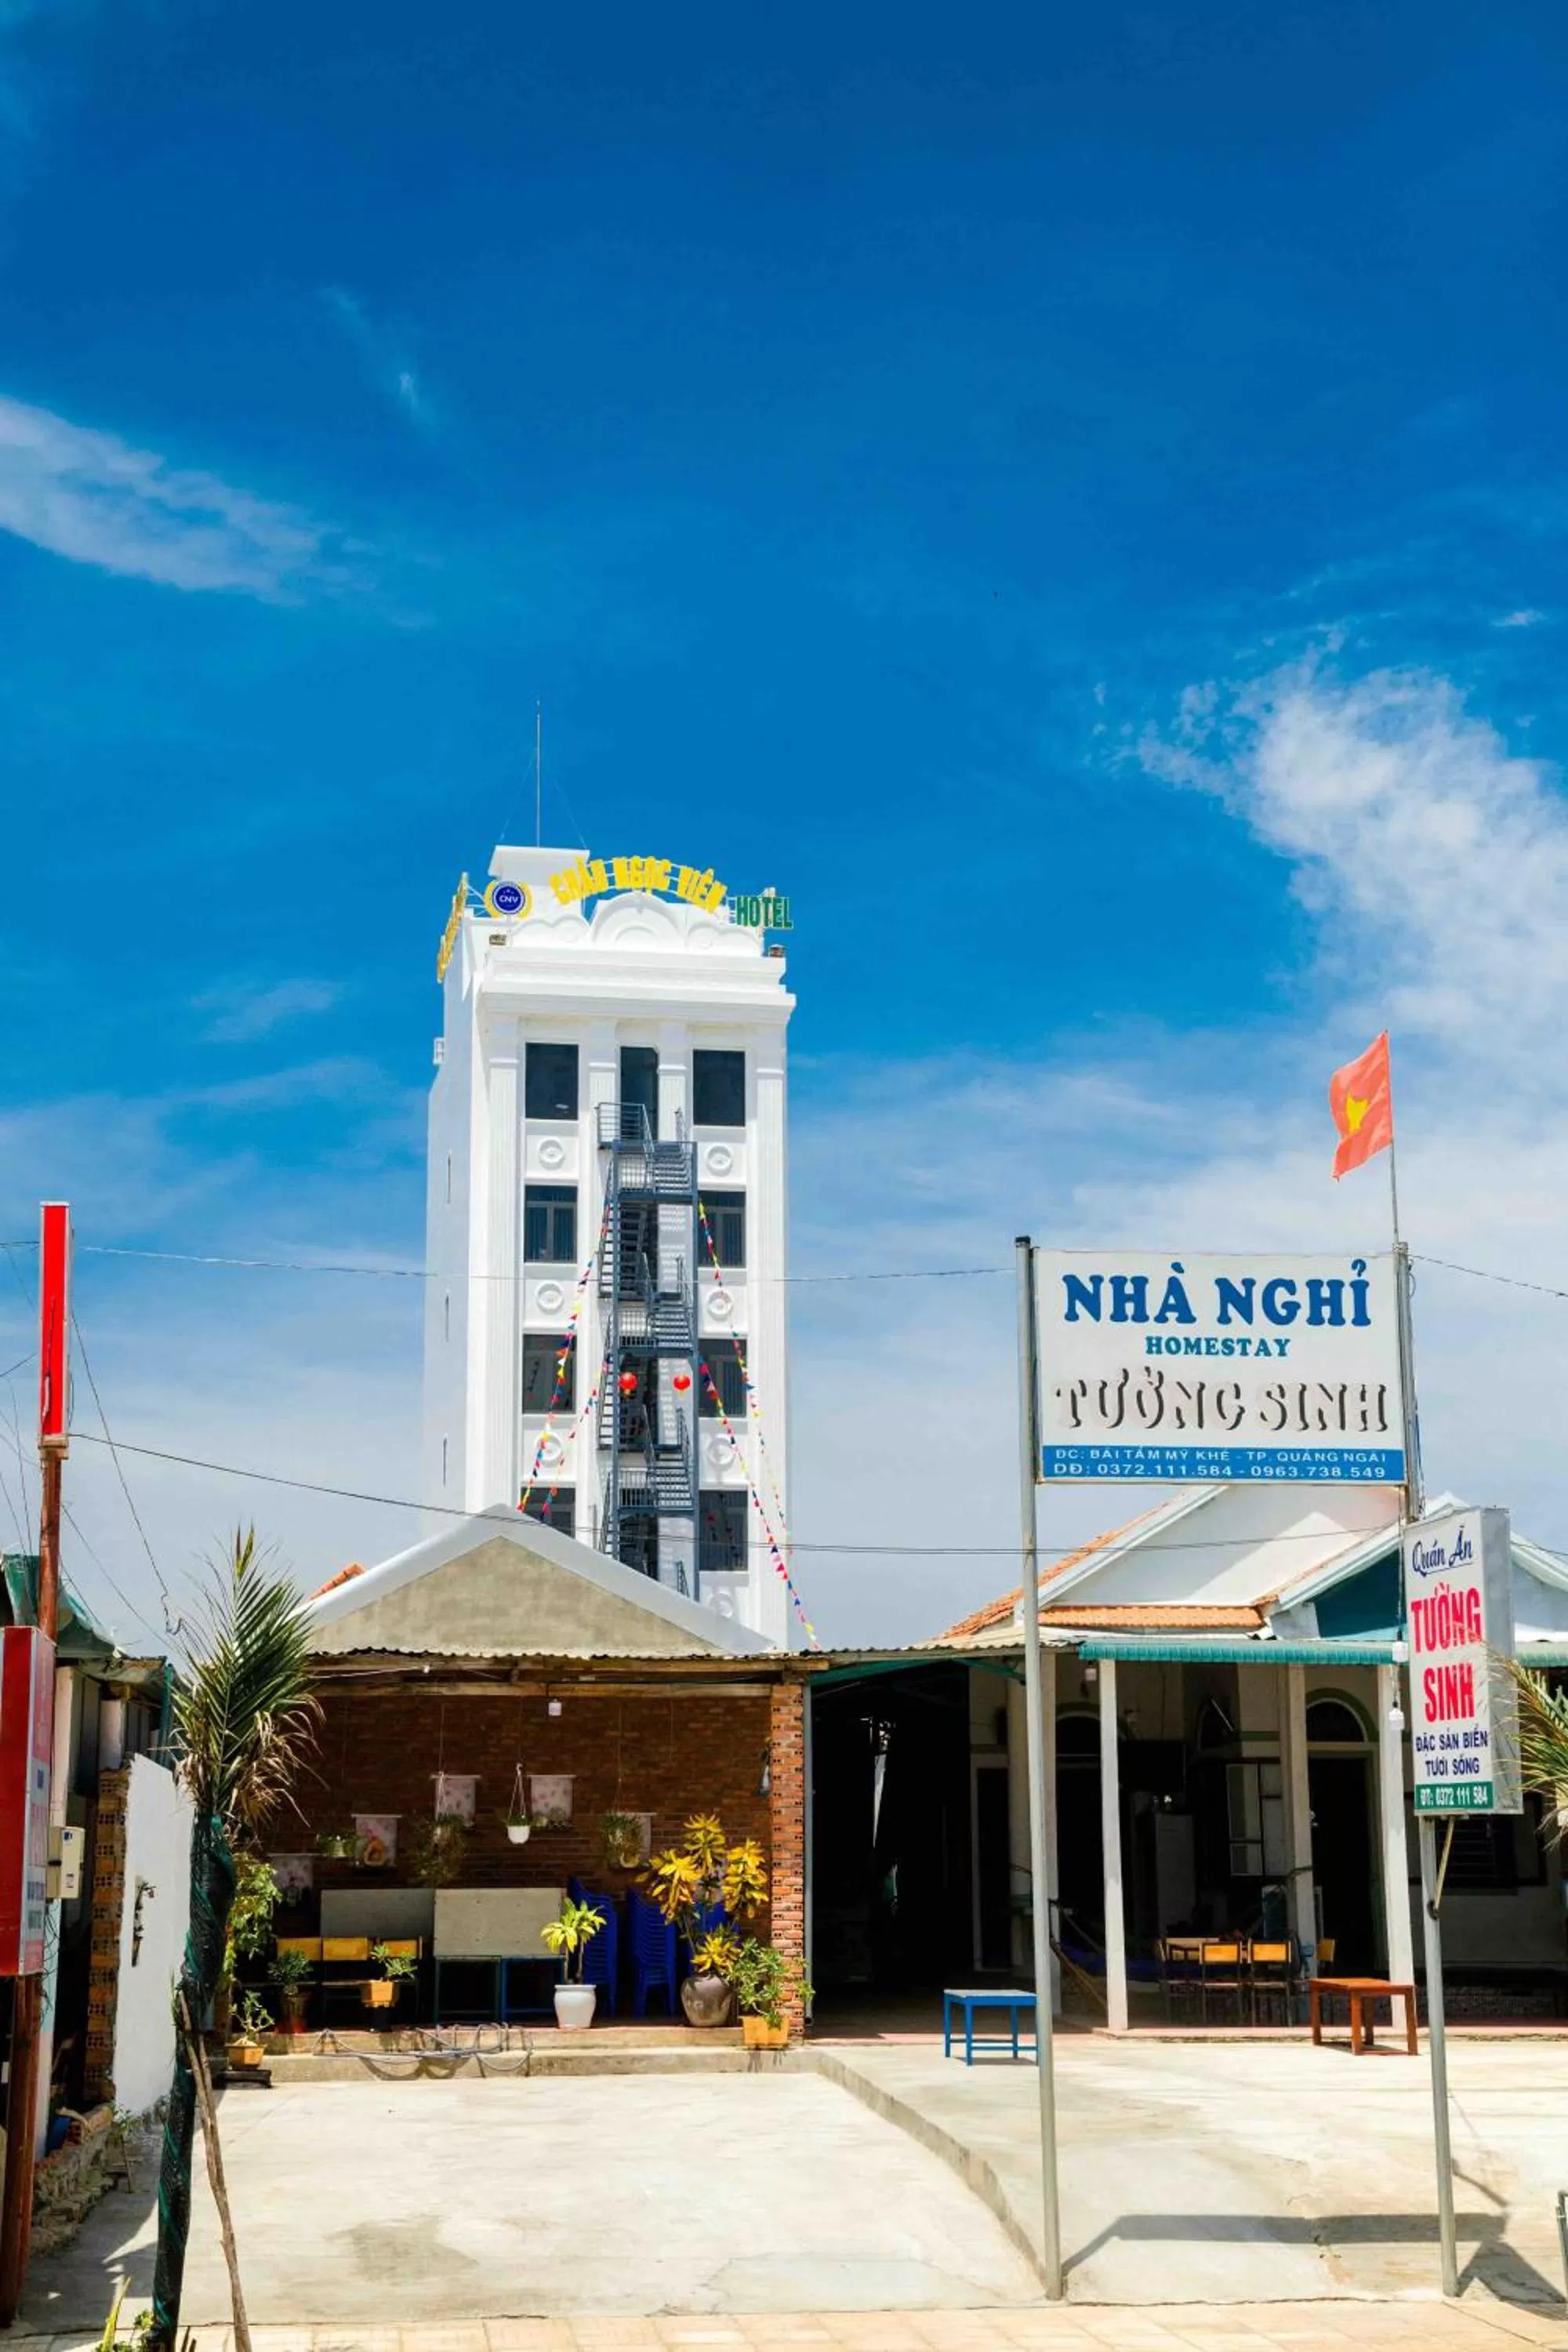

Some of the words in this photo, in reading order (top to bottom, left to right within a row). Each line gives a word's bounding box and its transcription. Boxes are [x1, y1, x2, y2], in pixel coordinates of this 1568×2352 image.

[498, 894, 519, 905] CNV
[736, 895, 793, 928] HOTEL
[1061, 1261, 1196, 1325] NHÀ
[1214, 1258, 1372, 1327] NGHỈ
[1145, 1335, 1291, 1358] HOMESTAY
[1259, 1382, 1388, 1432] SINH
[1097, 1463, 1232, 1476] 0372.111.584
[1250, 1465, 1386, 1479] 0963.738.549
[1247, 1451, 1272, 1462] TP.
[1412, 1538, 1446, 1577] Quán
[1448, 1524, 1473, 1567] Ăn
[1410, 1581, 1482, 1653] TƯỜNG
[1423, 1662, 1475, 1722] SINH
[1415, 1732, 1436, 1752] ĐẶC
[1439, 1727, 1459, 1751] SẢN
[1462, 1723, 1488, 1749] BIỂN
[1451, 1753, 1480, 1777] SỐNG
[1436, 1787, 1454, 1806] 0372
[1457, 1787, 1470, 1806] 111
